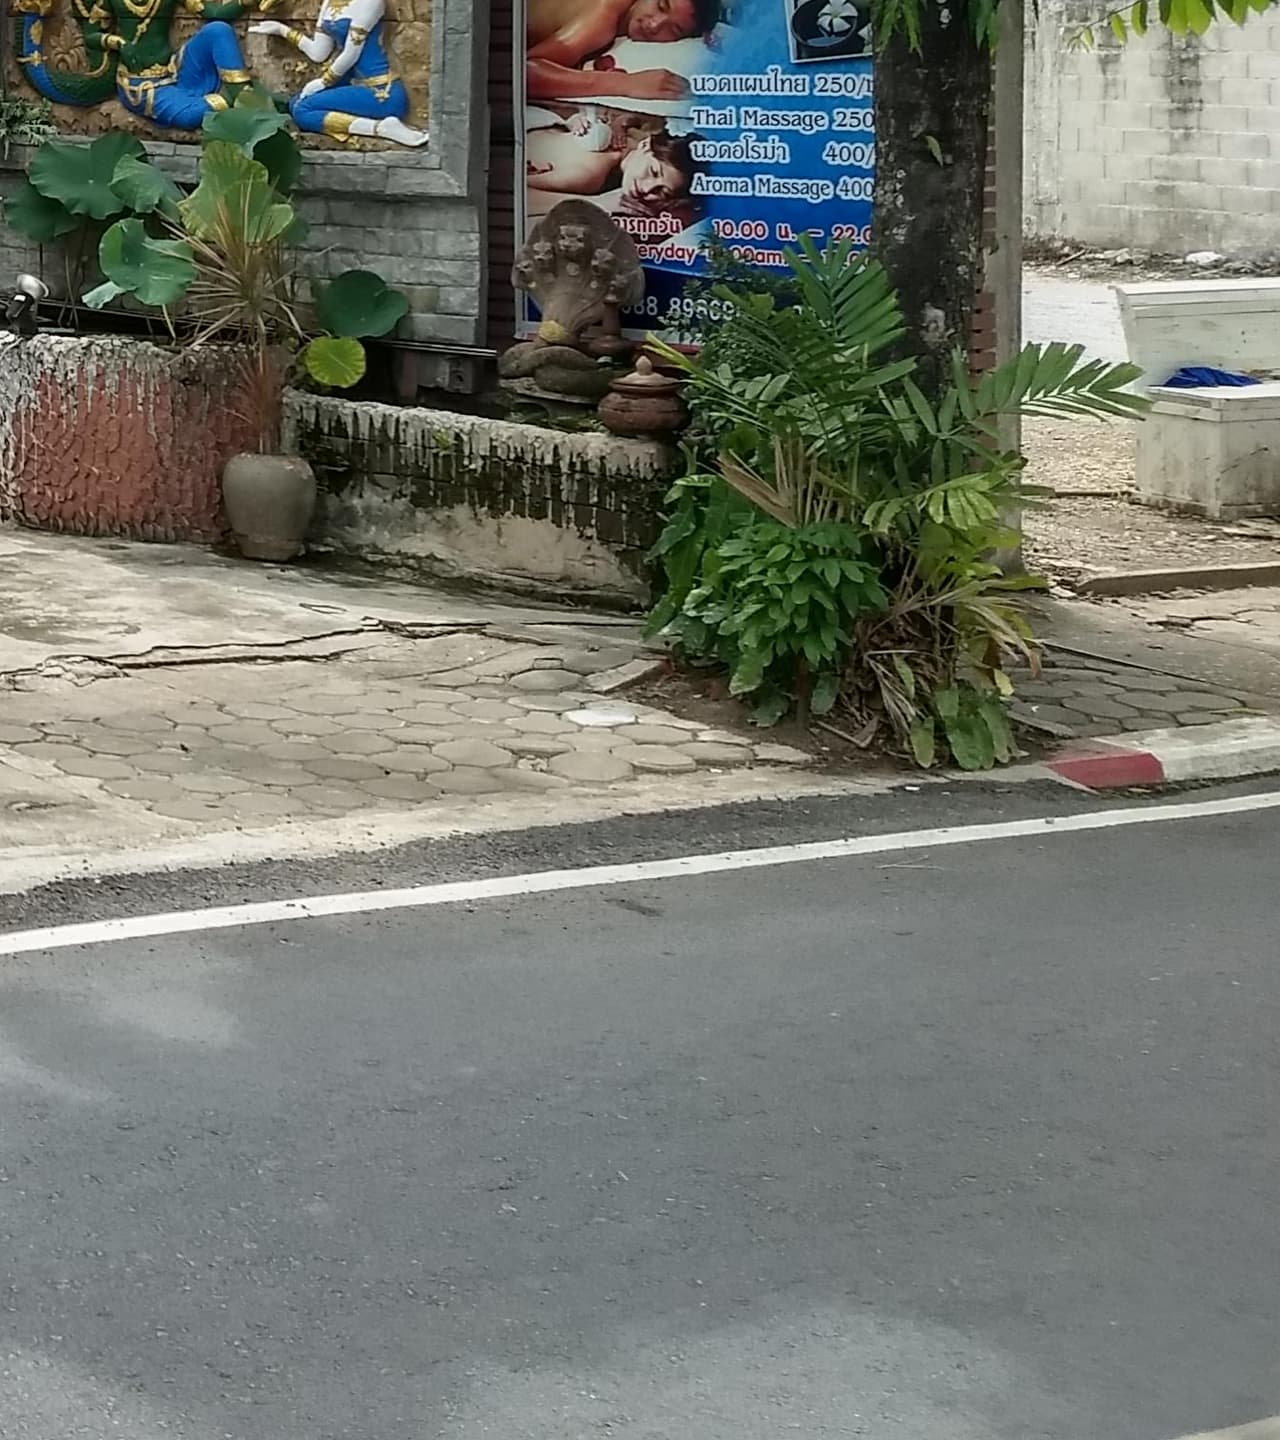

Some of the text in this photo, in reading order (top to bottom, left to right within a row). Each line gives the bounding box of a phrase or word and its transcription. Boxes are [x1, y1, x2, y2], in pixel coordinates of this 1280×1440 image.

[692, 66, 808, 95] นวดแผนไทย
[693, 108, 735, 127] Thai
[742, 108, 827, 133] Massage
[691, 134, 788, 162] นวดอโรม่า
[692, 174, 750, 194] Aroma
[756, 176, 832, 201] Massage
